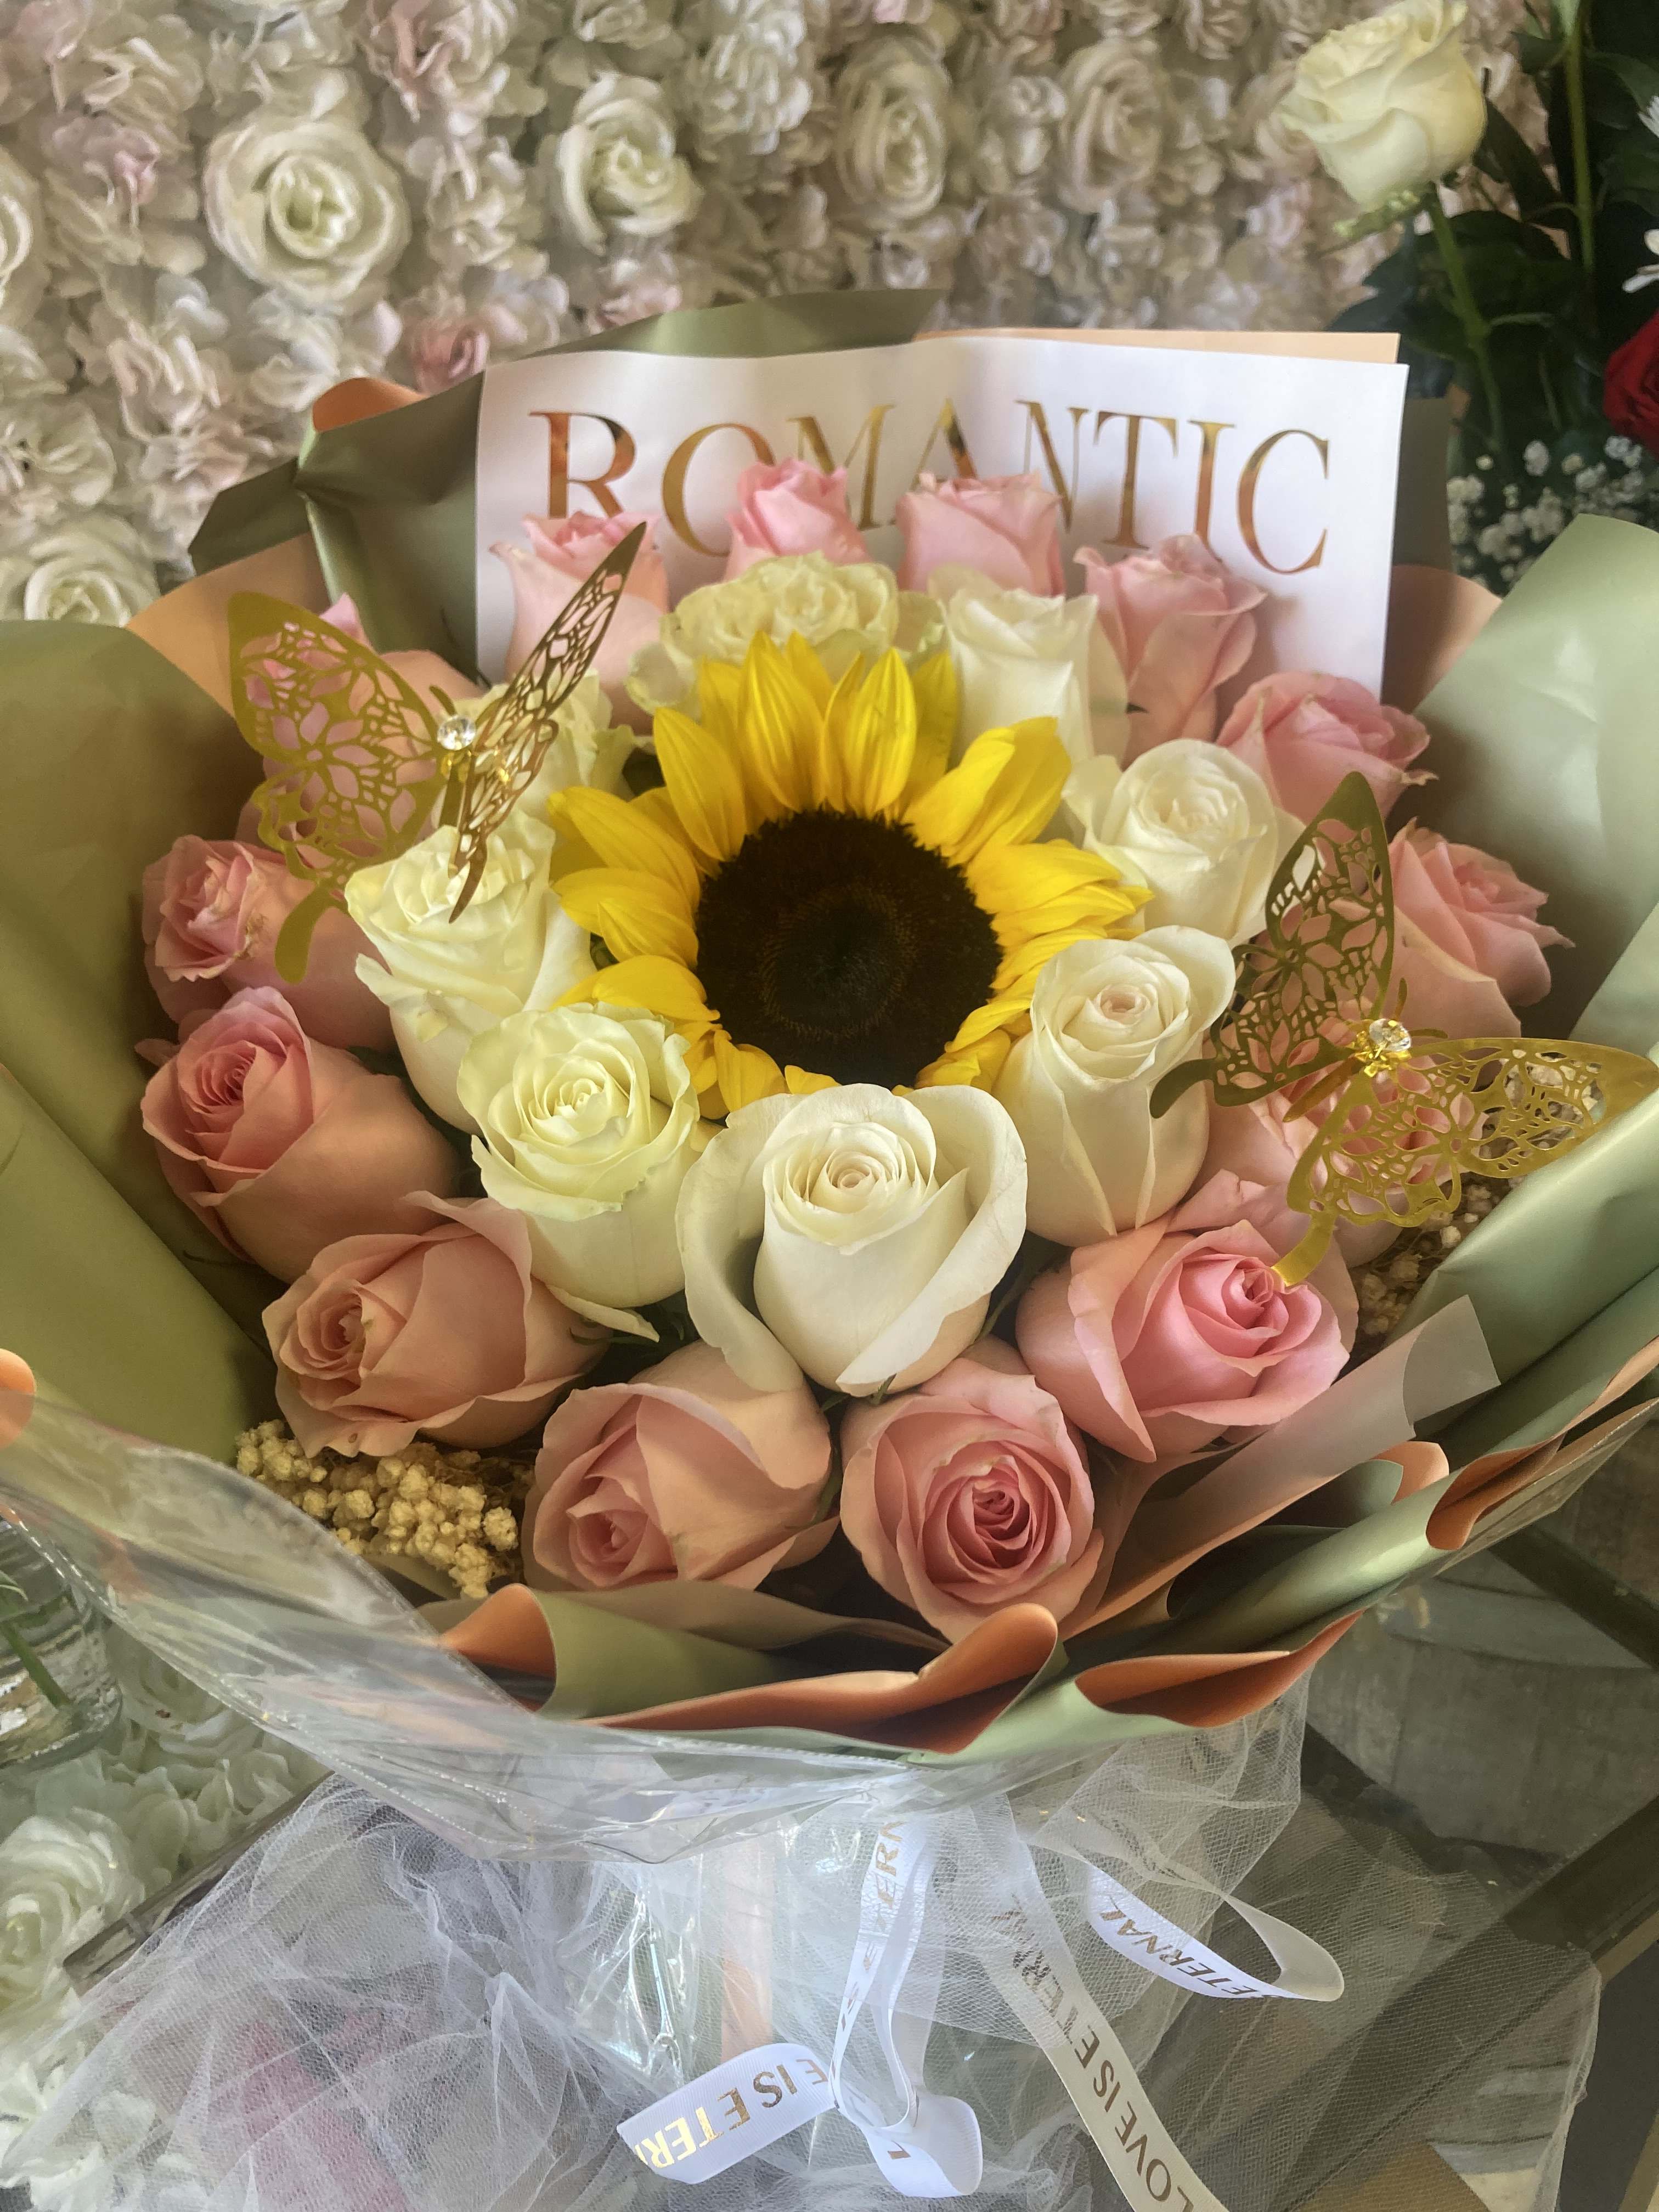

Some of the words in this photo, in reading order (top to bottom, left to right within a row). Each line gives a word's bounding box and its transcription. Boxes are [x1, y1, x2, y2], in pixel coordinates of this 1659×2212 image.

[528, 398, 1329, 575] ROMANTIC
[1100, 1895, 1259, 1996] ETERNAL
[753, 2064, 798, 2108] IS
[1092, 2059, 1121, 2113] IS
[1114, 2100, 1195, 2212] LOVE
